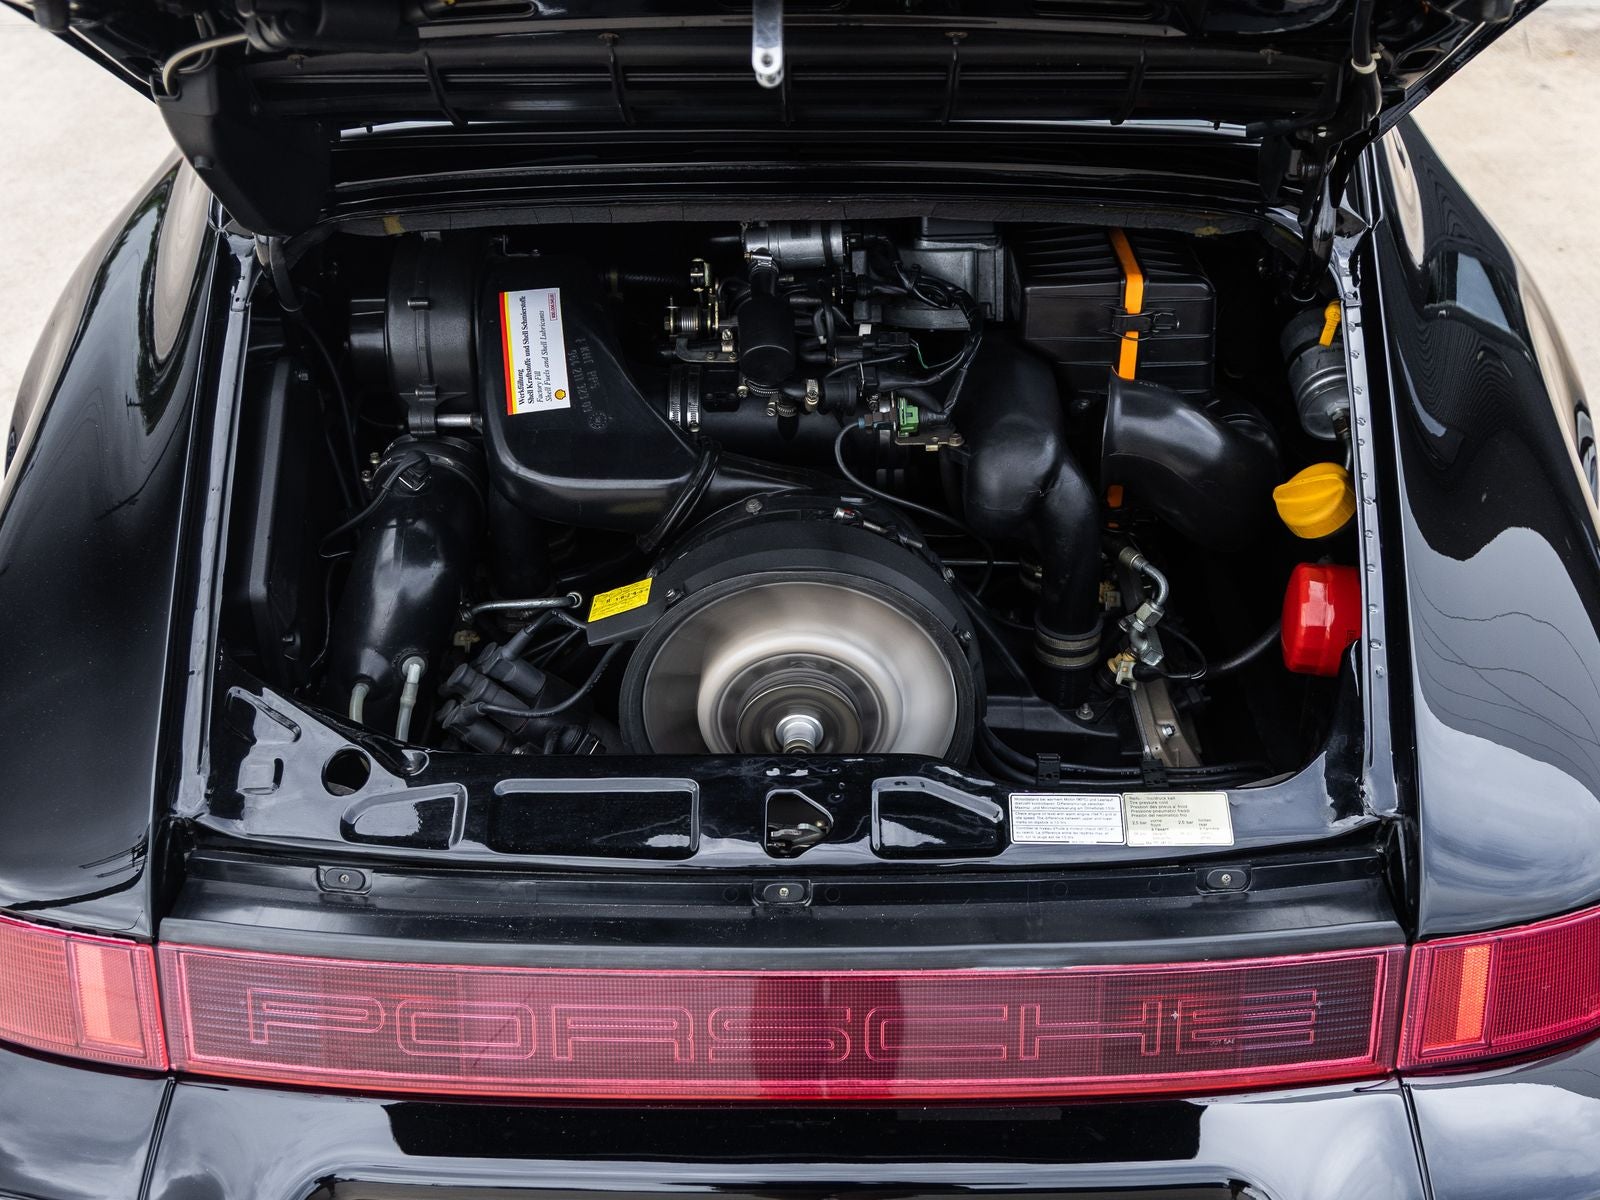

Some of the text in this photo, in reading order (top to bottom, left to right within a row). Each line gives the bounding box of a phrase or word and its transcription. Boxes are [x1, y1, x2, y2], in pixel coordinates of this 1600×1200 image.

[520, 296, 529, 329] Schmierstoffe
[539, 310, 547, 339] Lubricants
[525, 358, 534, 388] Kraftstoffe
[246, 986, 1319, 1064] PORSCHE
